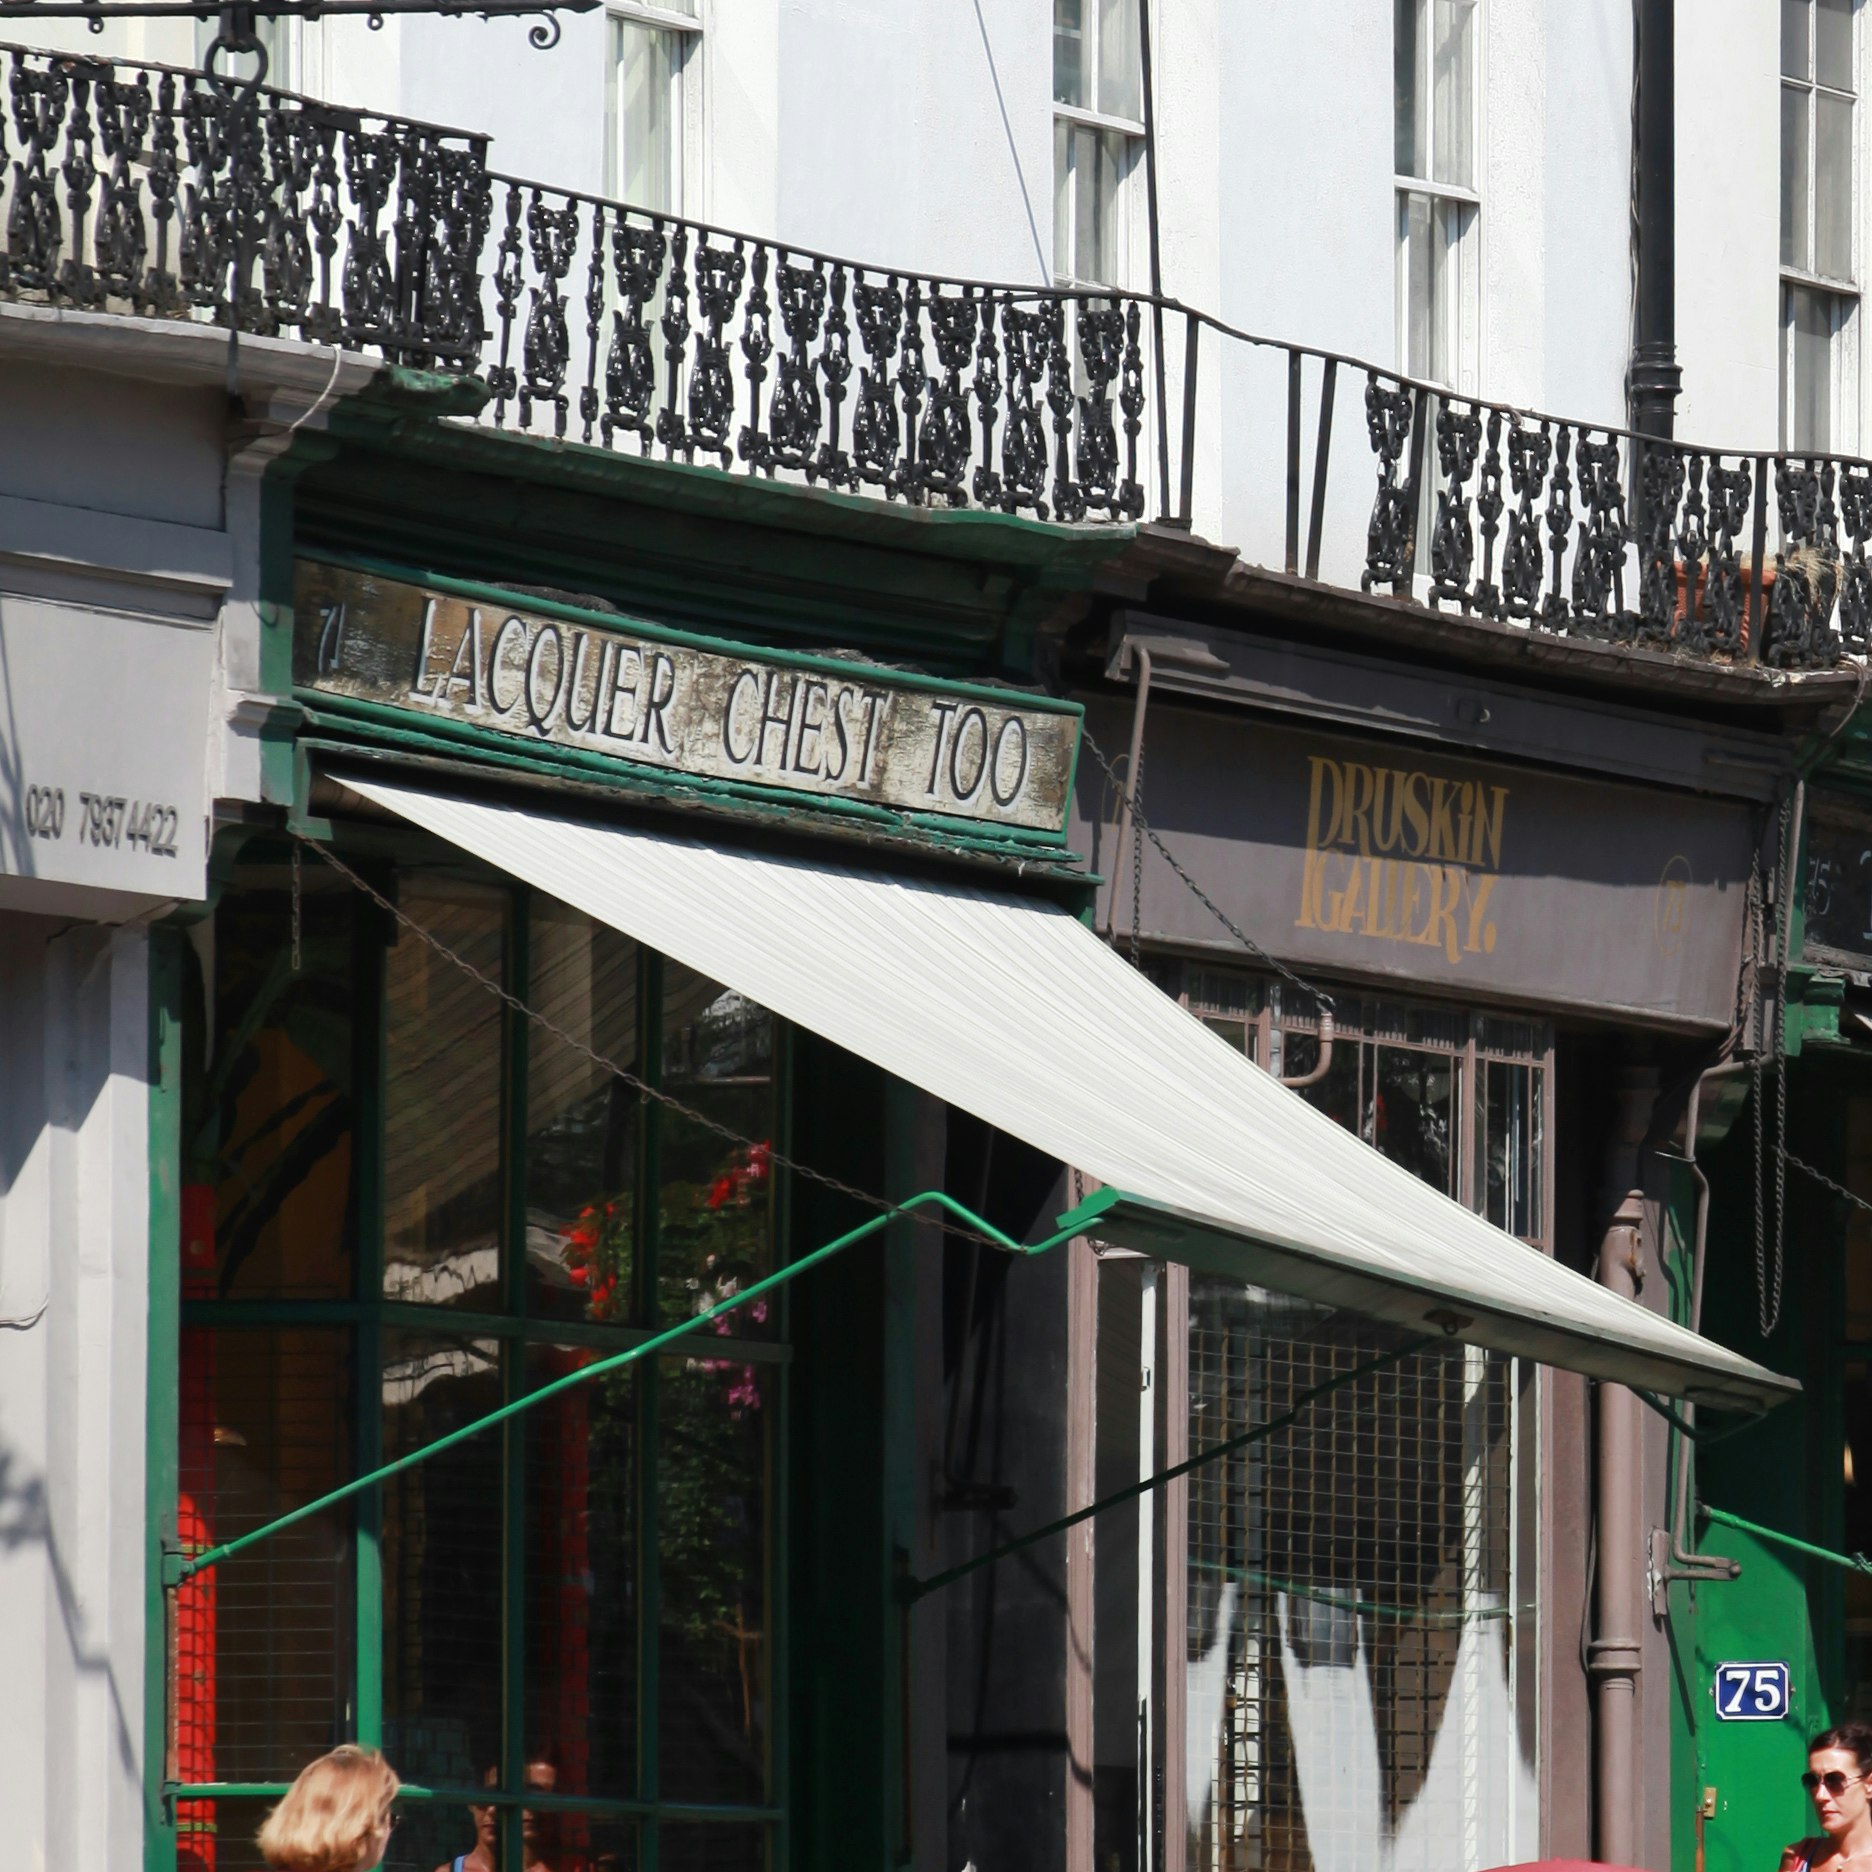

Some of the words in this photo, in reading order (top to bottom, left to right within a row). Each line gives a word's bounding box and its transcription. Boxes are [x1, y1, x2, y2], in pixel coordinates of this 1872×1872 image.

[409, 596, 677, 755] LACQUER
[723, 667, 893, 789] CHEST
[925, 700, 1030, 811] TOO
[26, 783, 65, 840] 020
[1725, 1670, 1781, 1714] 75
